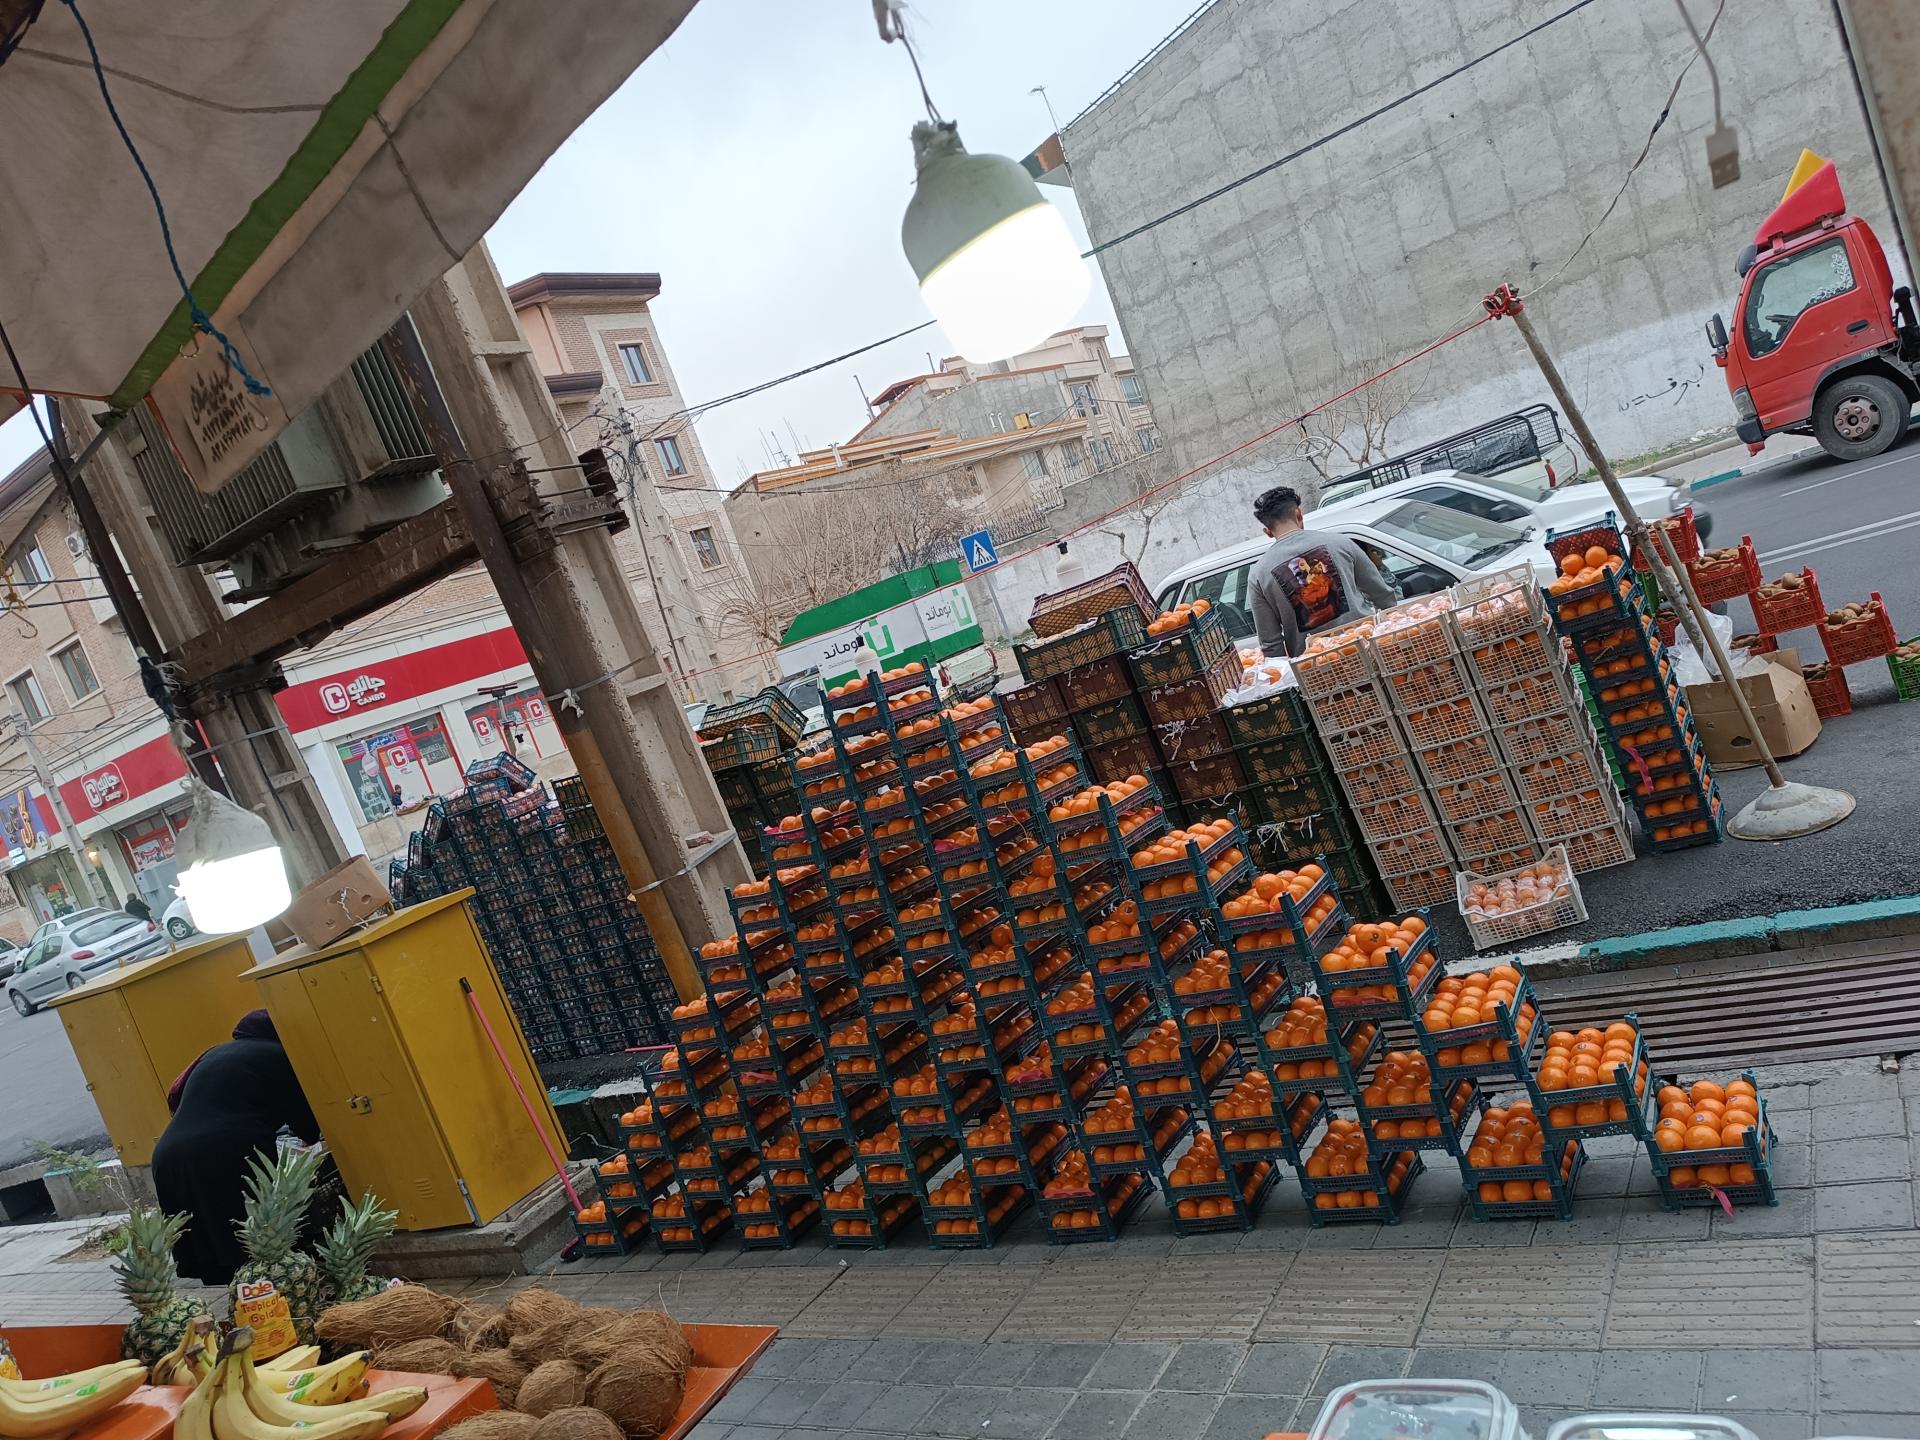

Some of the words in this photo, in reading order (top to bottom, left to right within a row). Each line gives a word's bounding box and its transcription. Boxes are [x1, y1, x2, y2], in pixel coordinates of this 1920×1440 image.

[925, 602, 952, 621] نوماند
[823, 638, 861, 660] وماند
[242, 1282, 272, 1298] Dole
[241, 1296, 280, 1313] Tropical
[250, 1310, 275, 1323] Gold
